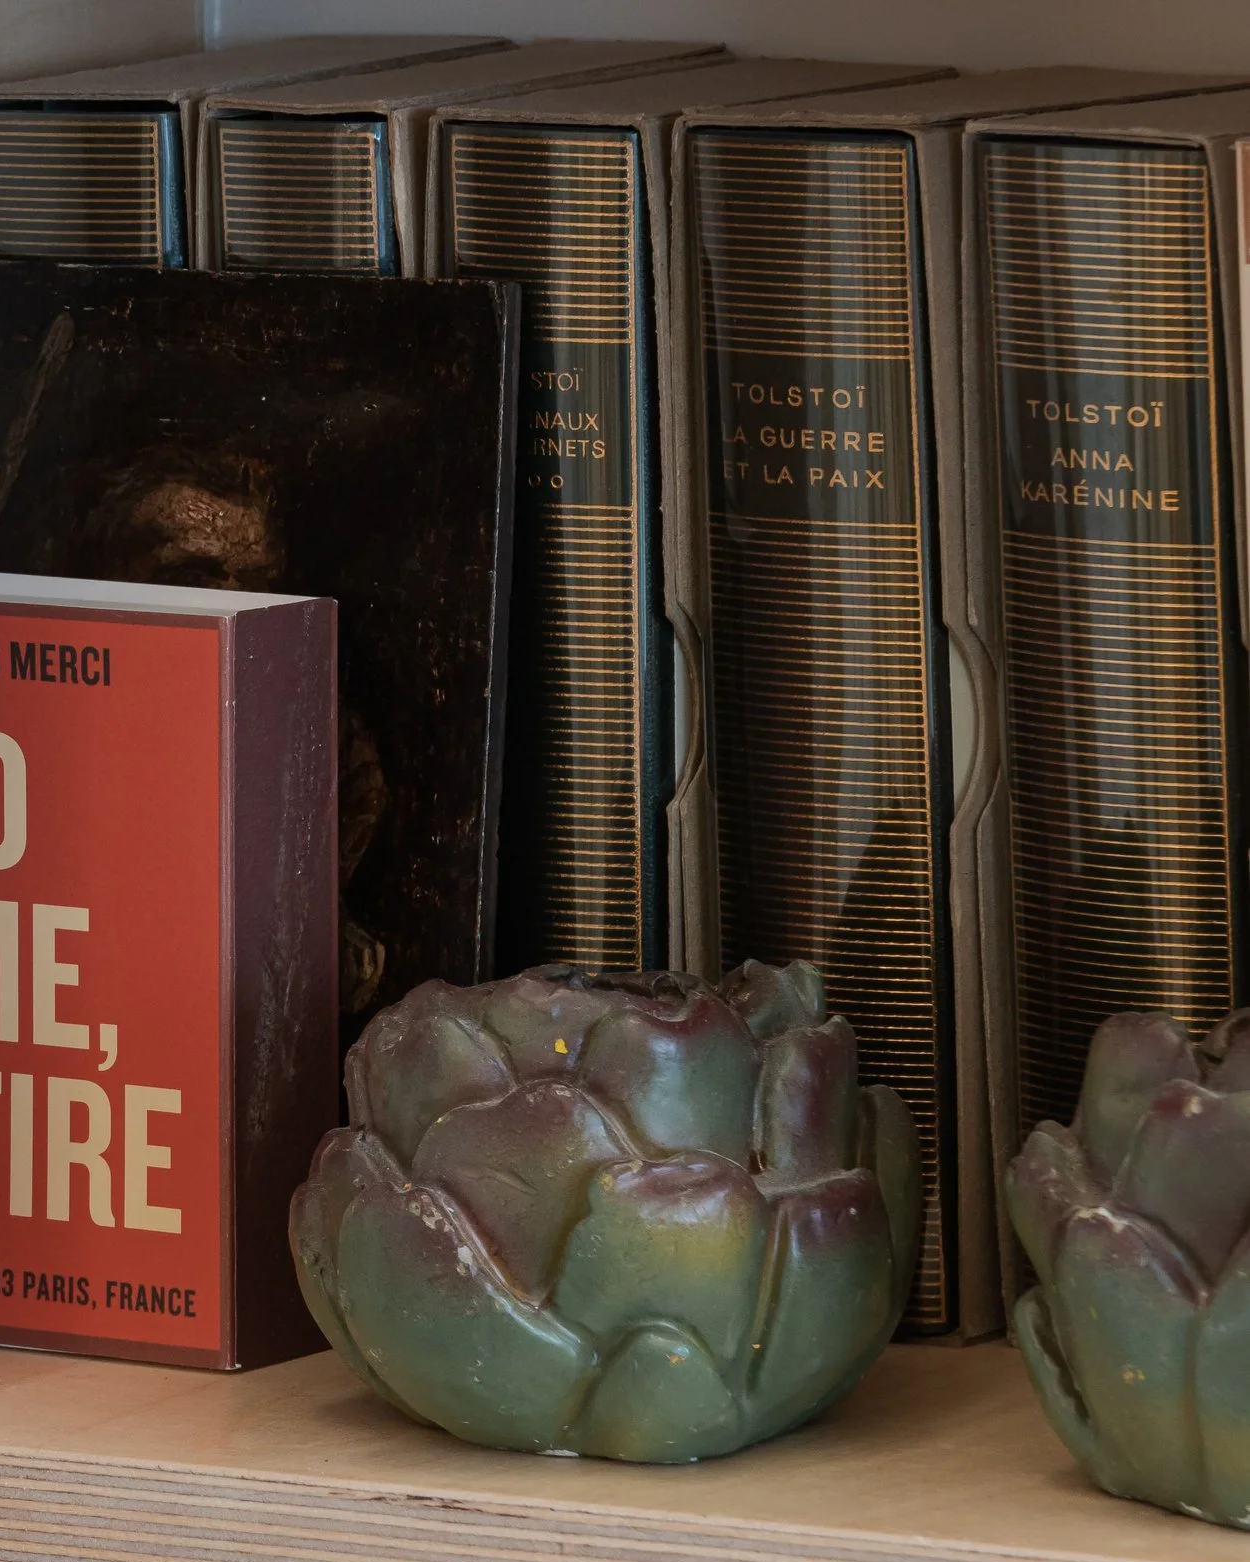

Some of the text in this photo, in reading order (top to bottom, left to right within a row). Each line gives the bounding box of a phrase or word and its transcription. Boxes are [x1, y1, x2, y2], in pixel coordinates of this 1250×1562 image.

[731, 382, 867, 409] TOLSTOÏ
[530, 410, 600, 432] NAUX
[1025, 399, 1165, 428] TOLSTOÏ
[721, 422, 885, 453] LA GUERRE
[722, 459, 885, 490] ET LA PAIX
[1050, 446, 1135, 473] ANNA
[1020, 478, 1181, 512] KARÉNINE
[10, 641, 111, 687] MERCI
[22, 1270, 97, 1311] PARIS,
[105, 1279, 197, 1318] FRANCE
